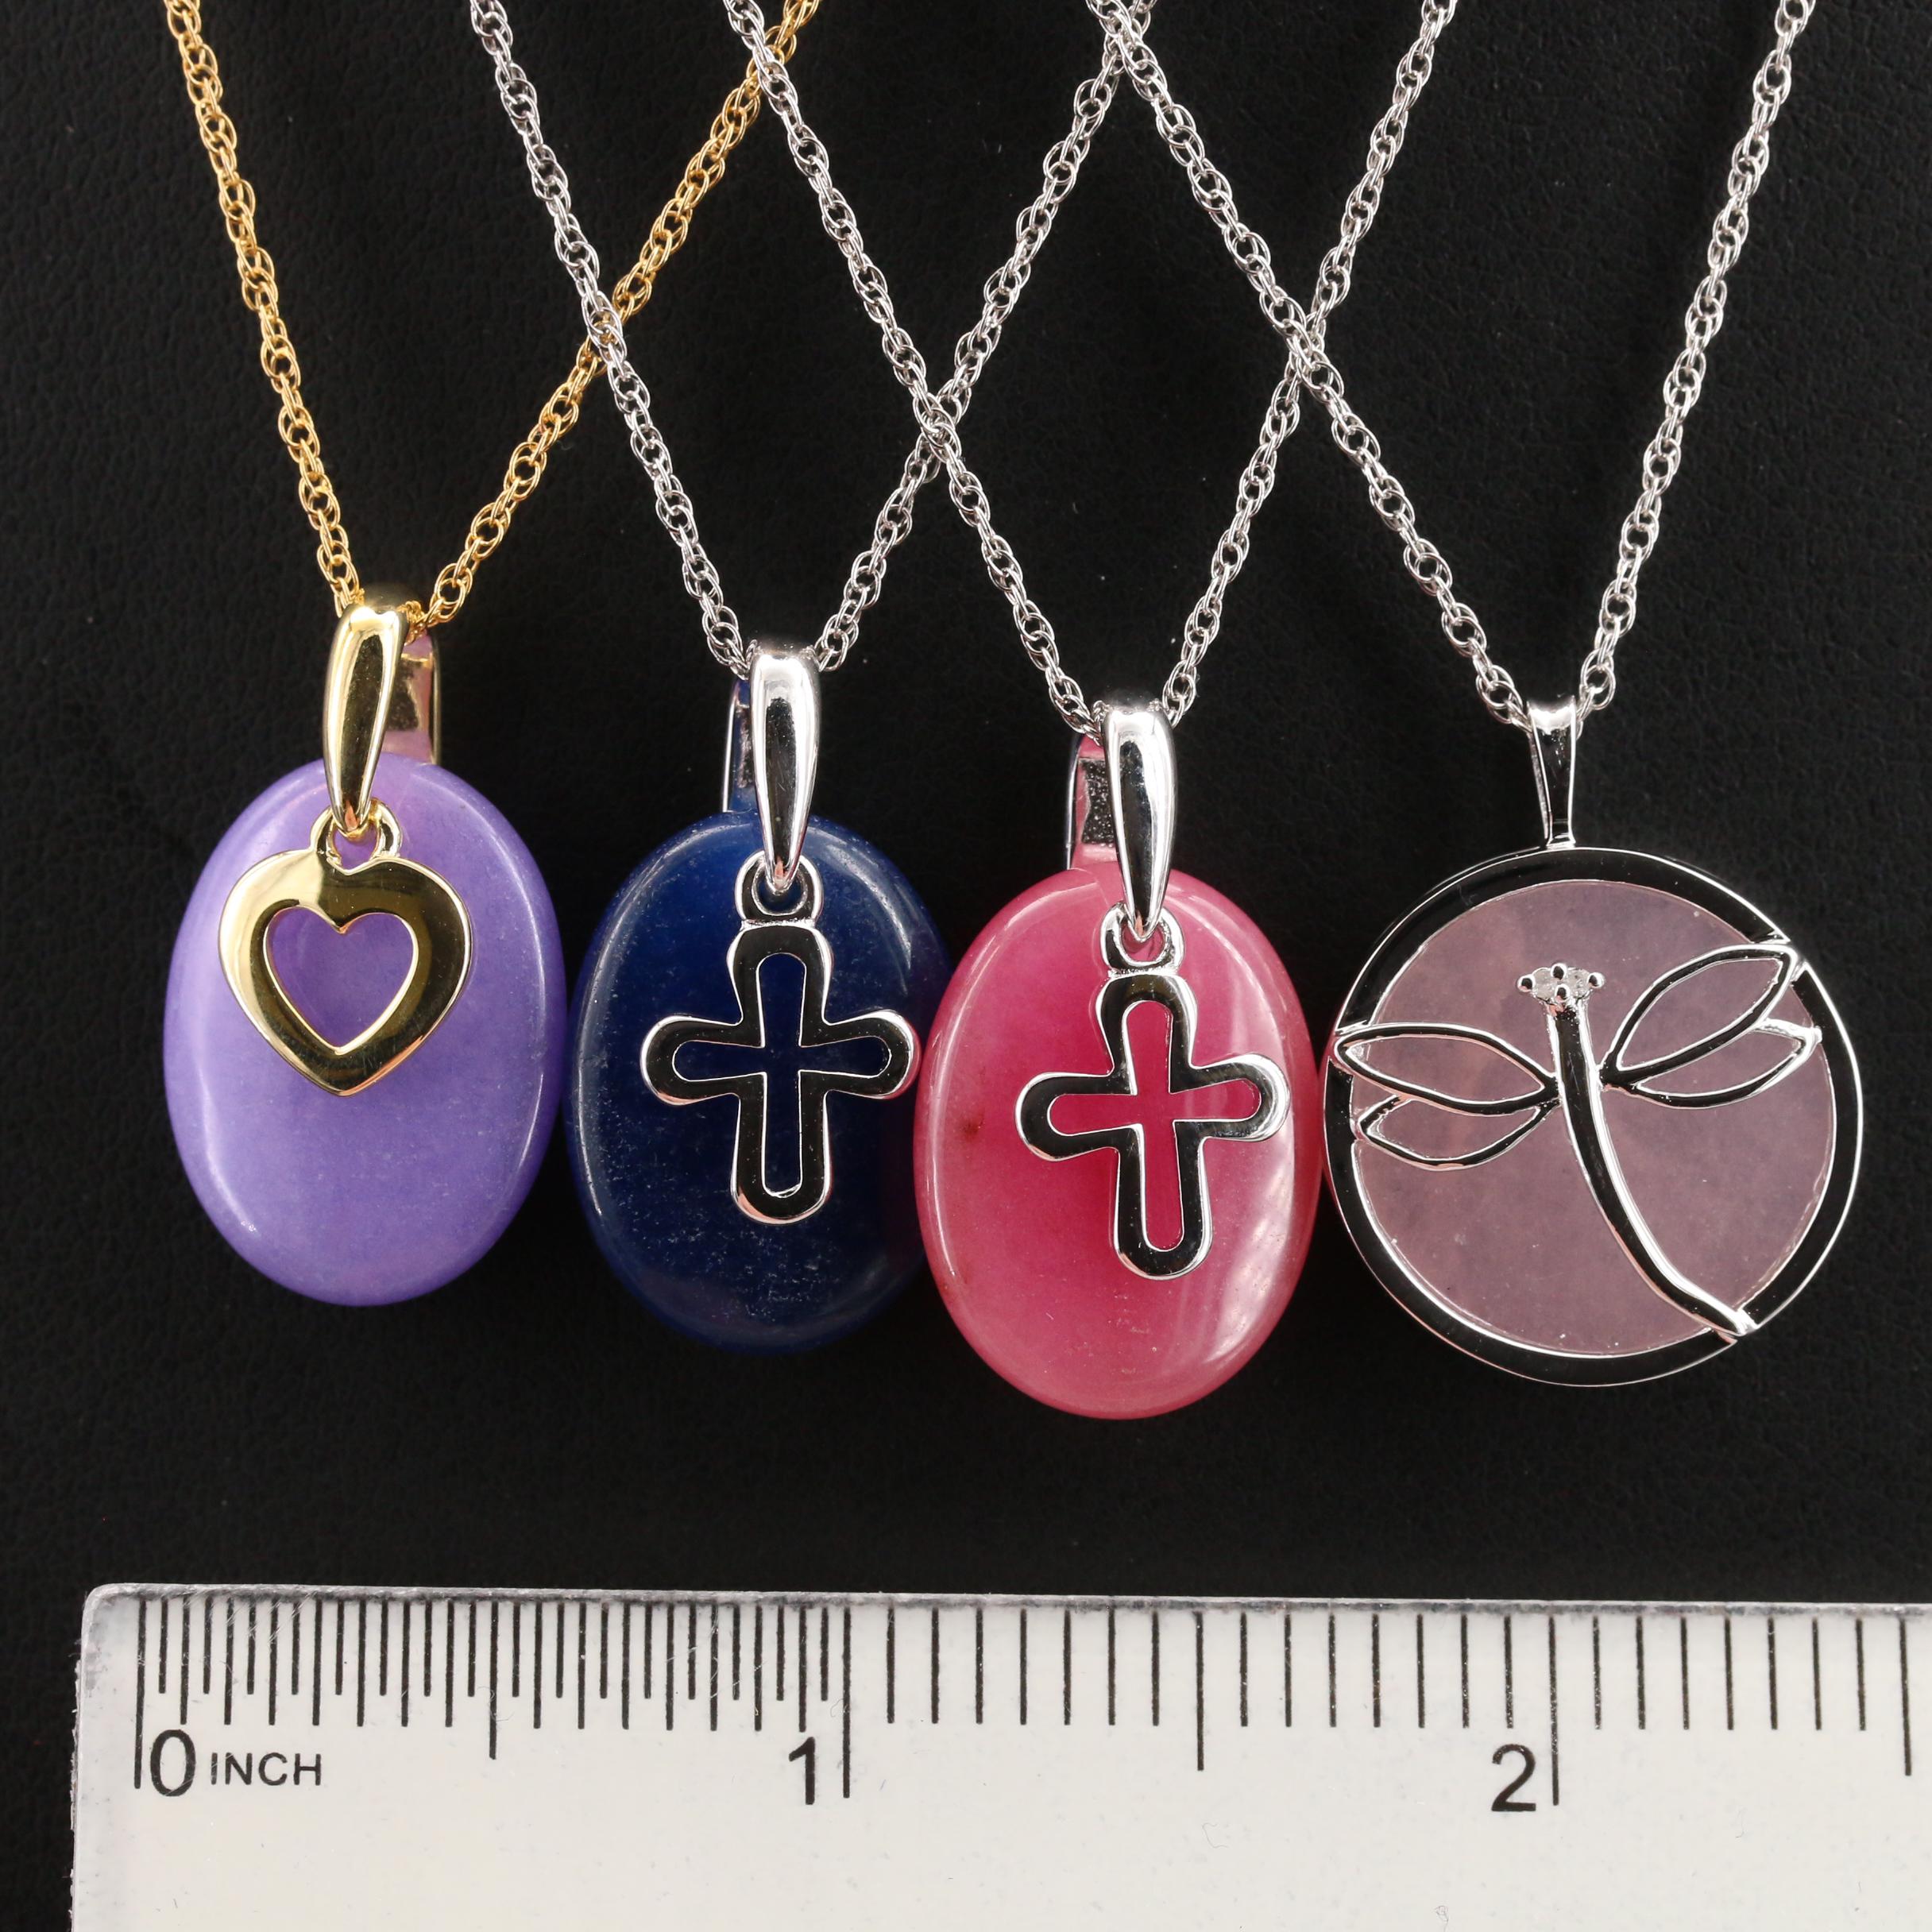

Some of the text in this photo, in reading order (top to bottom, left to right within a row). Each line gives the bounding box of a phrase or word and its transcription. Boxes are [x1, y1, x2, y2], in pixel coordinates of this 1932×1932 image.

[149, 1729, 322, 1797] 0 INCH
[788, 1737, 816, 1806] 1
[1490, 1744, 1537, 1812] 2
